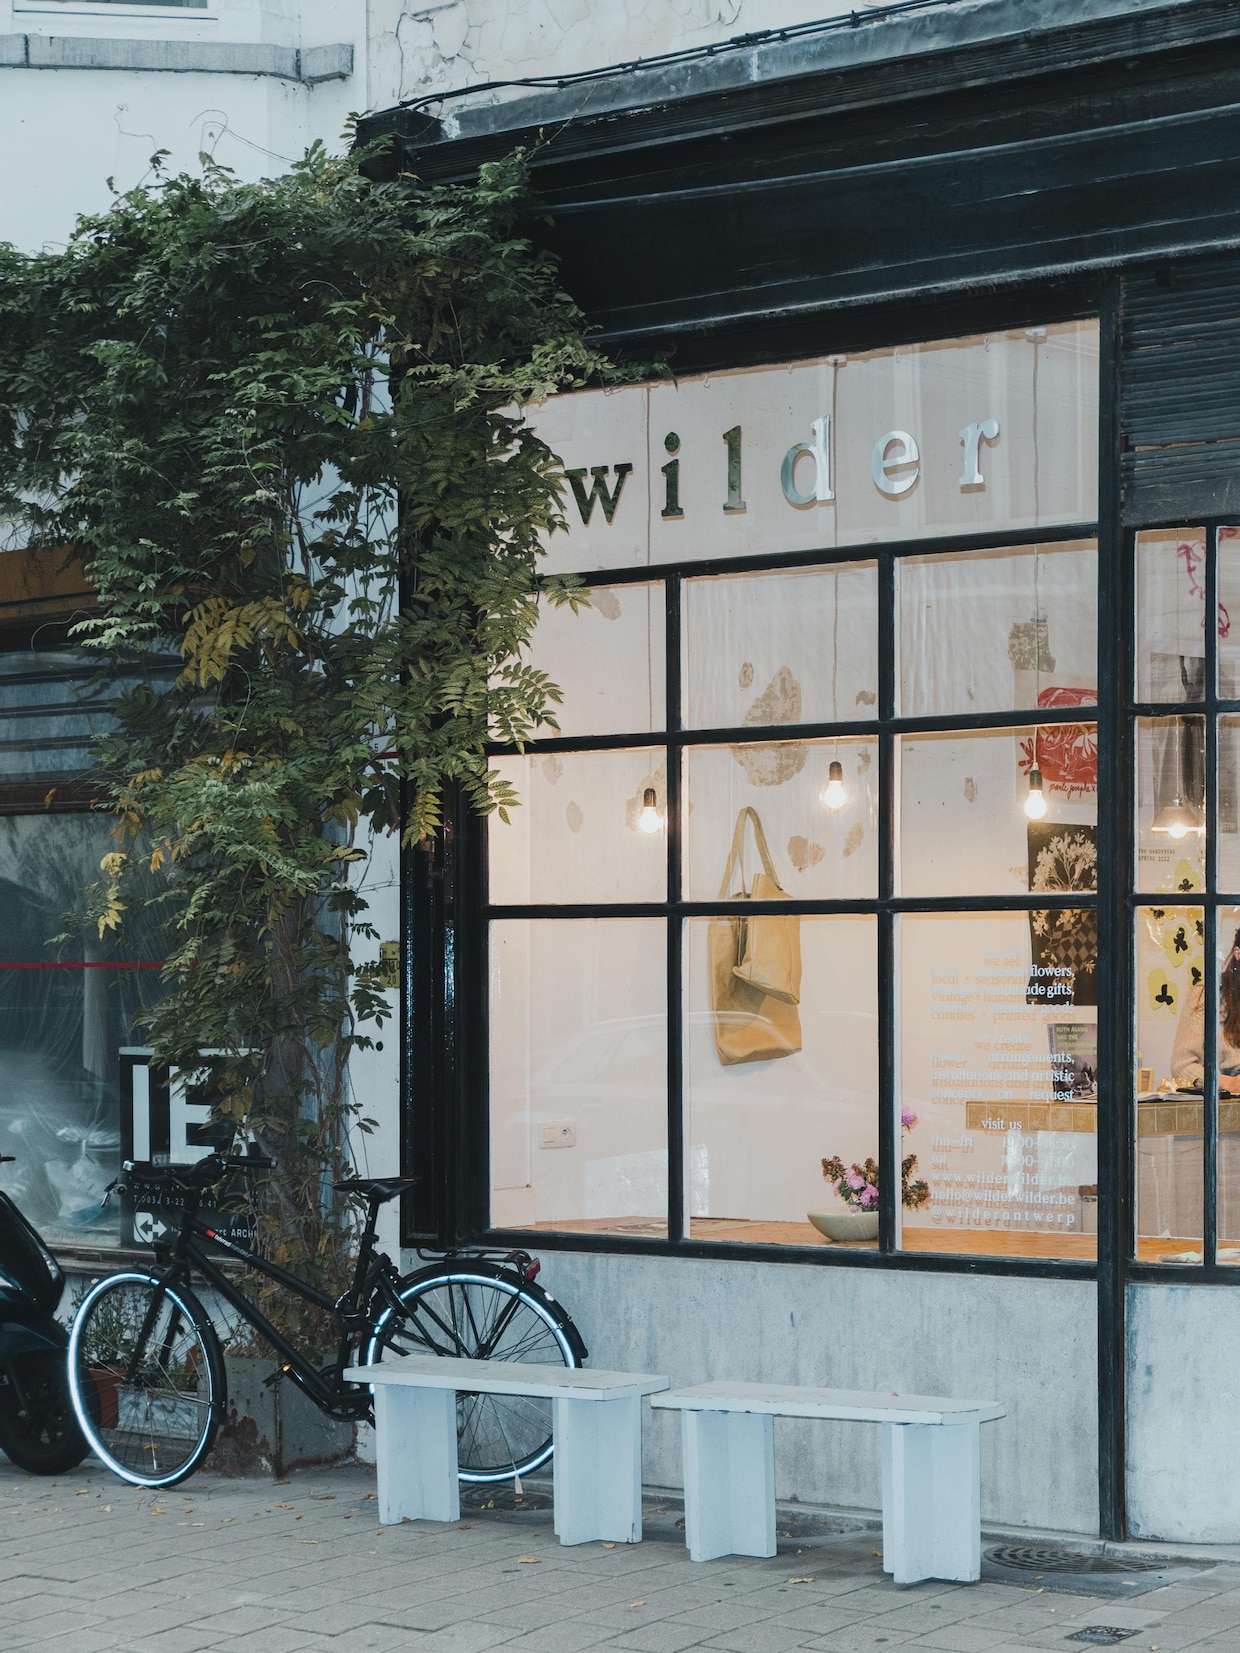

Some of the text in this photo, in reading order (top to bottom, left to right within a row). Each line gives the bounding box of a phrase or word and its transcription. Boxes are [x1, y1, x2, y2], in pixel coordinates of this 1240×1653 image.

[564, 414, 999, 526] wilder
[1030, 964, 1076, 978] flowers,
[1046, 983, 1076, 998] gifts,
[981, 1116, 1022, 1130] visit us
[931, 1171, 1075, 1186] www.wilderilder.be
